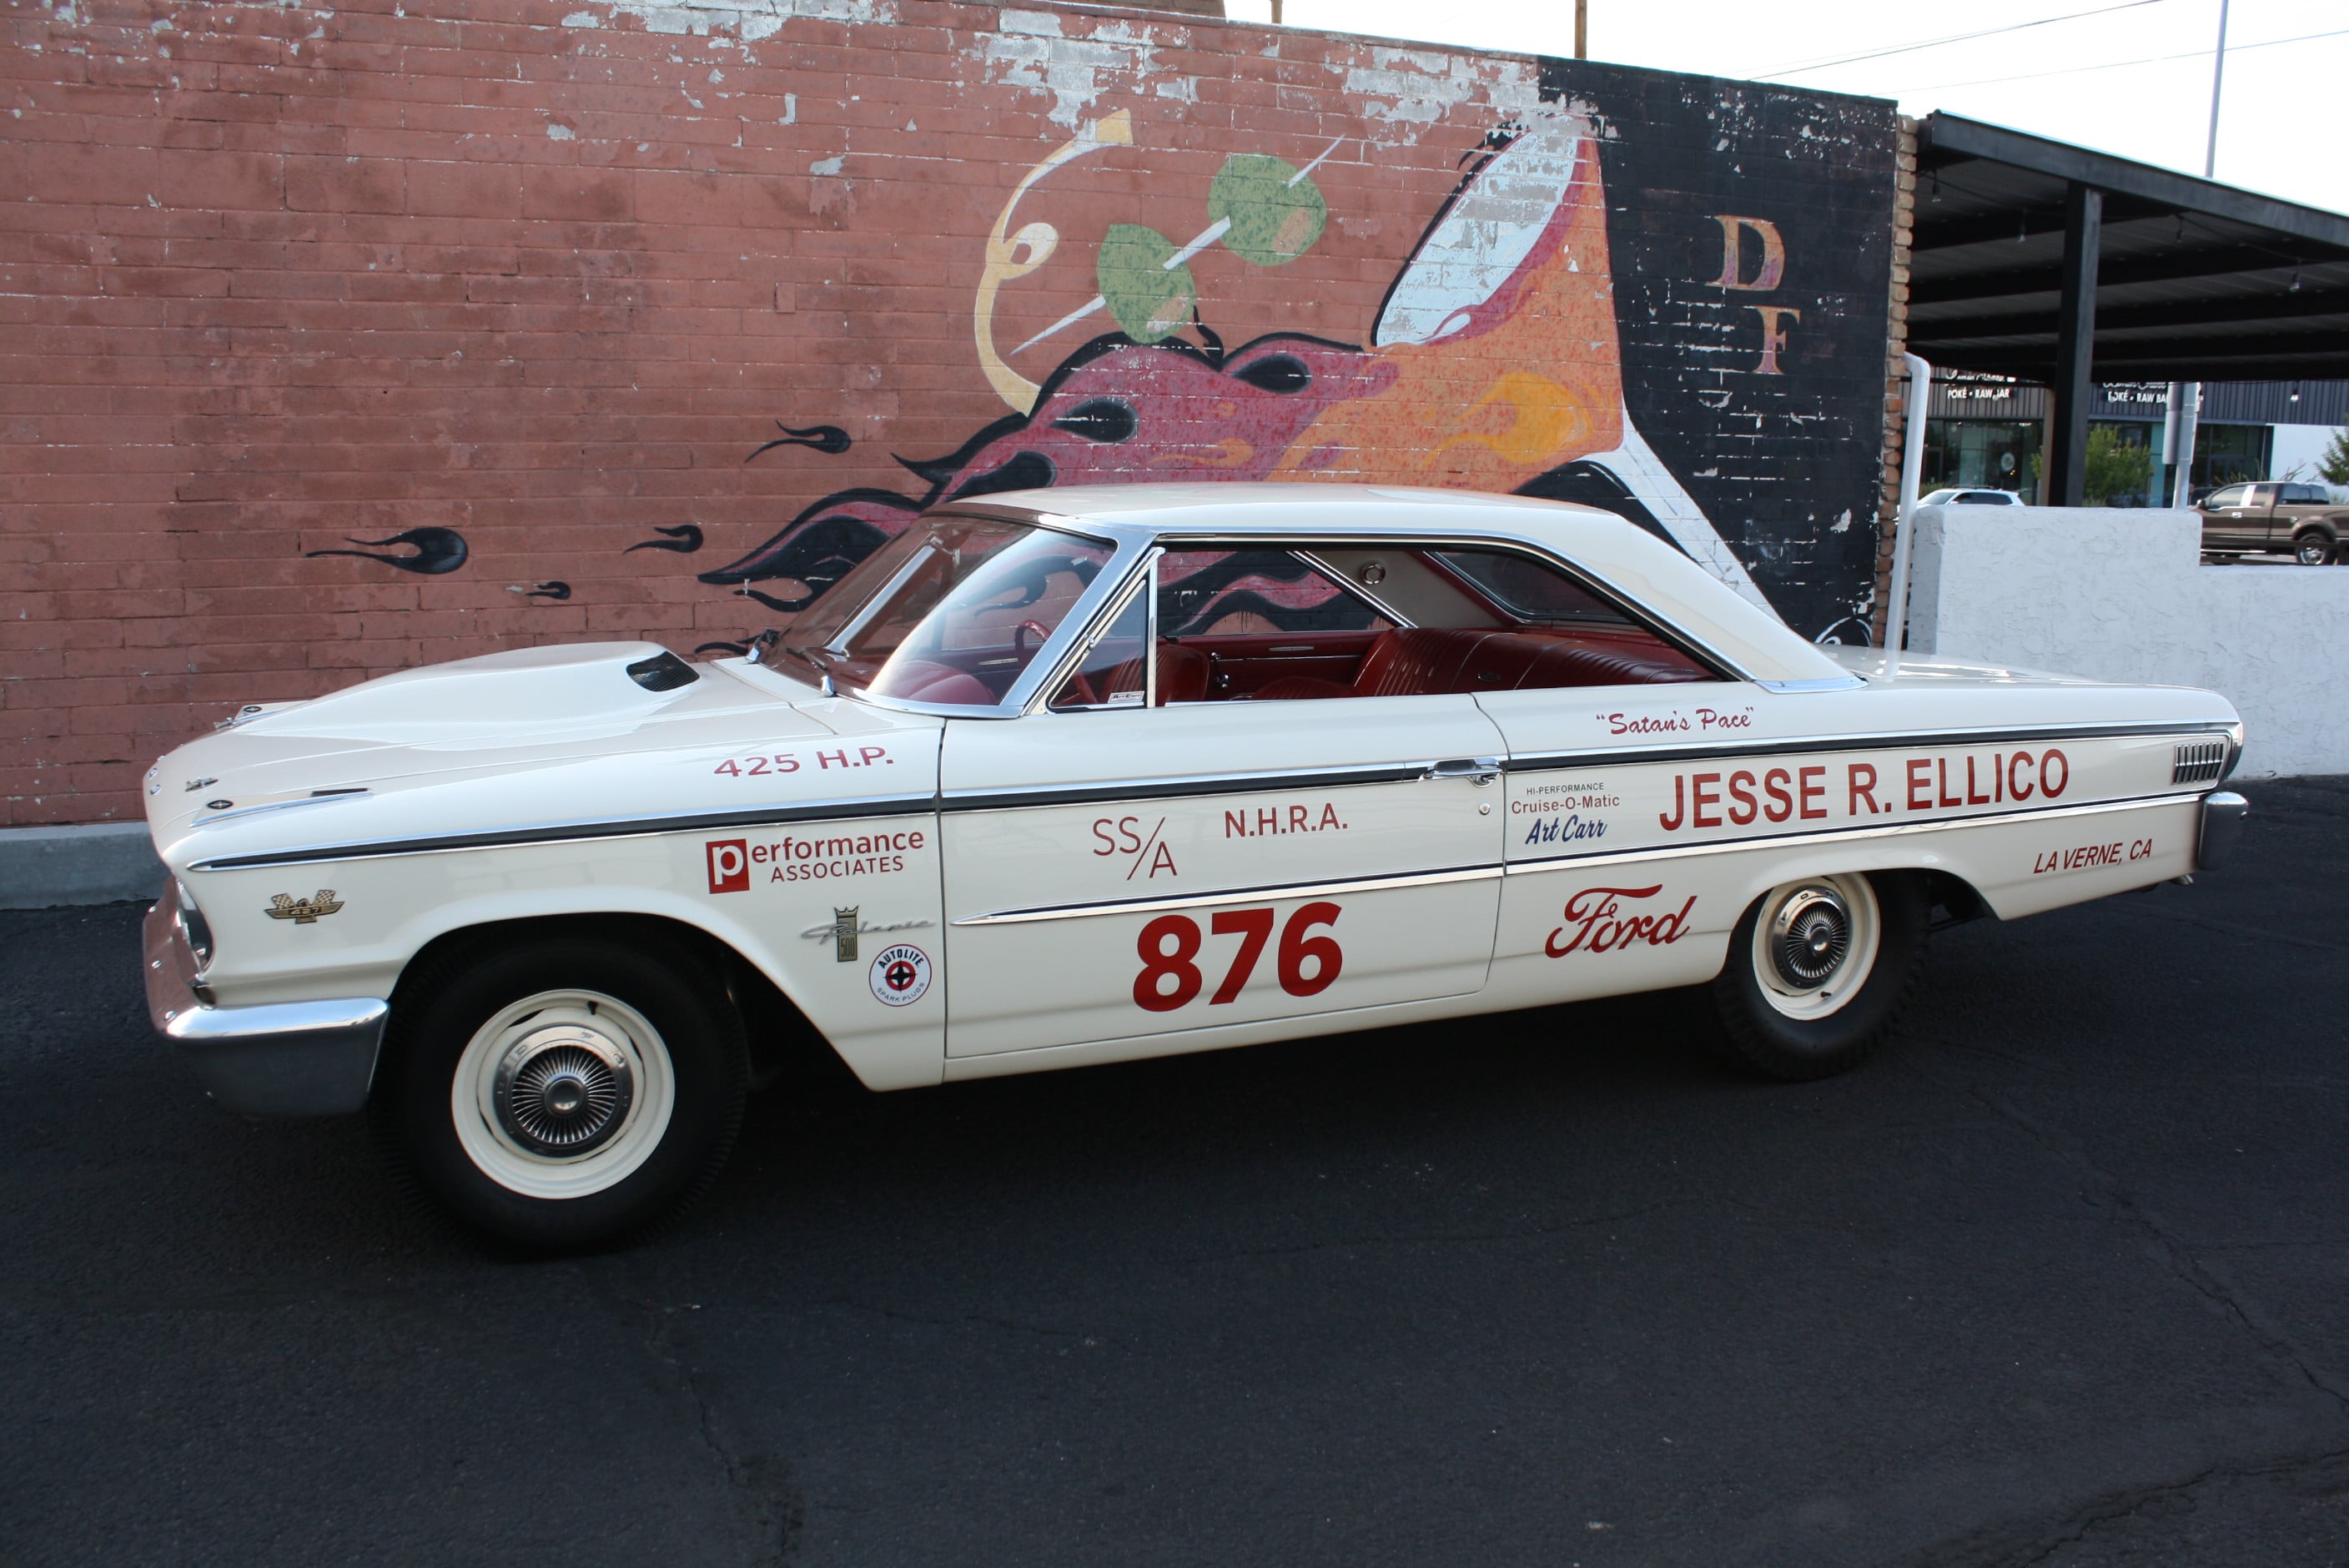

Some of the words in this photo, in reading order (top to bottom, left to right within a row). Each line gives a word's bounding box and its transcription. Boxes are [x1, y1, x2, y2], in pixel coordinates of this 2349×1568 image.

[1705, 215, 1785, 291] D
[1753, 306, 1800, 374] F
[1948, 387, 1967, 399] POKÉ
[1974, 389, 1992, 399] RAW
[2137, 393, 2155, 403] RAW
[713, 753, 801, 777] 425
[816, 746, 894, 770] H.P.
[1512, 794, 1620, 814] Cruise-O-Matic
[1527, 782, 1604, 796] HI-PERFORMANCE
[1659, 766, 1828, 832] JESSE
[1848, 762, 1892, 816] R.
[1906, 748, 2069, 811] ELLICO
[1225, 802, 1348, 838] N.H.R.A.
[1525, 817, 1560, 845] Art
[1562, 814, 1607, 842] Carr
[712, 831, 924, 885] performance
[771, 856, 903, 883] ASSOCIATES
[2033, 851, 2058, 874] LA
[2064, 842, 2123, 870] VERNE,
[2130, 838, 2152, 860] CA
[289, 907, 320, 916] 427
[1545, 884, 1698, 958] Ford
[840, 937, 855, 957] 500
[878, 948, 924, 968] AUTOLITE
[1133, 902, 1343, 1013] 876
[877, 987, 900, 1003] SPARK
[902, 982, 925, 1002] PLUGS
